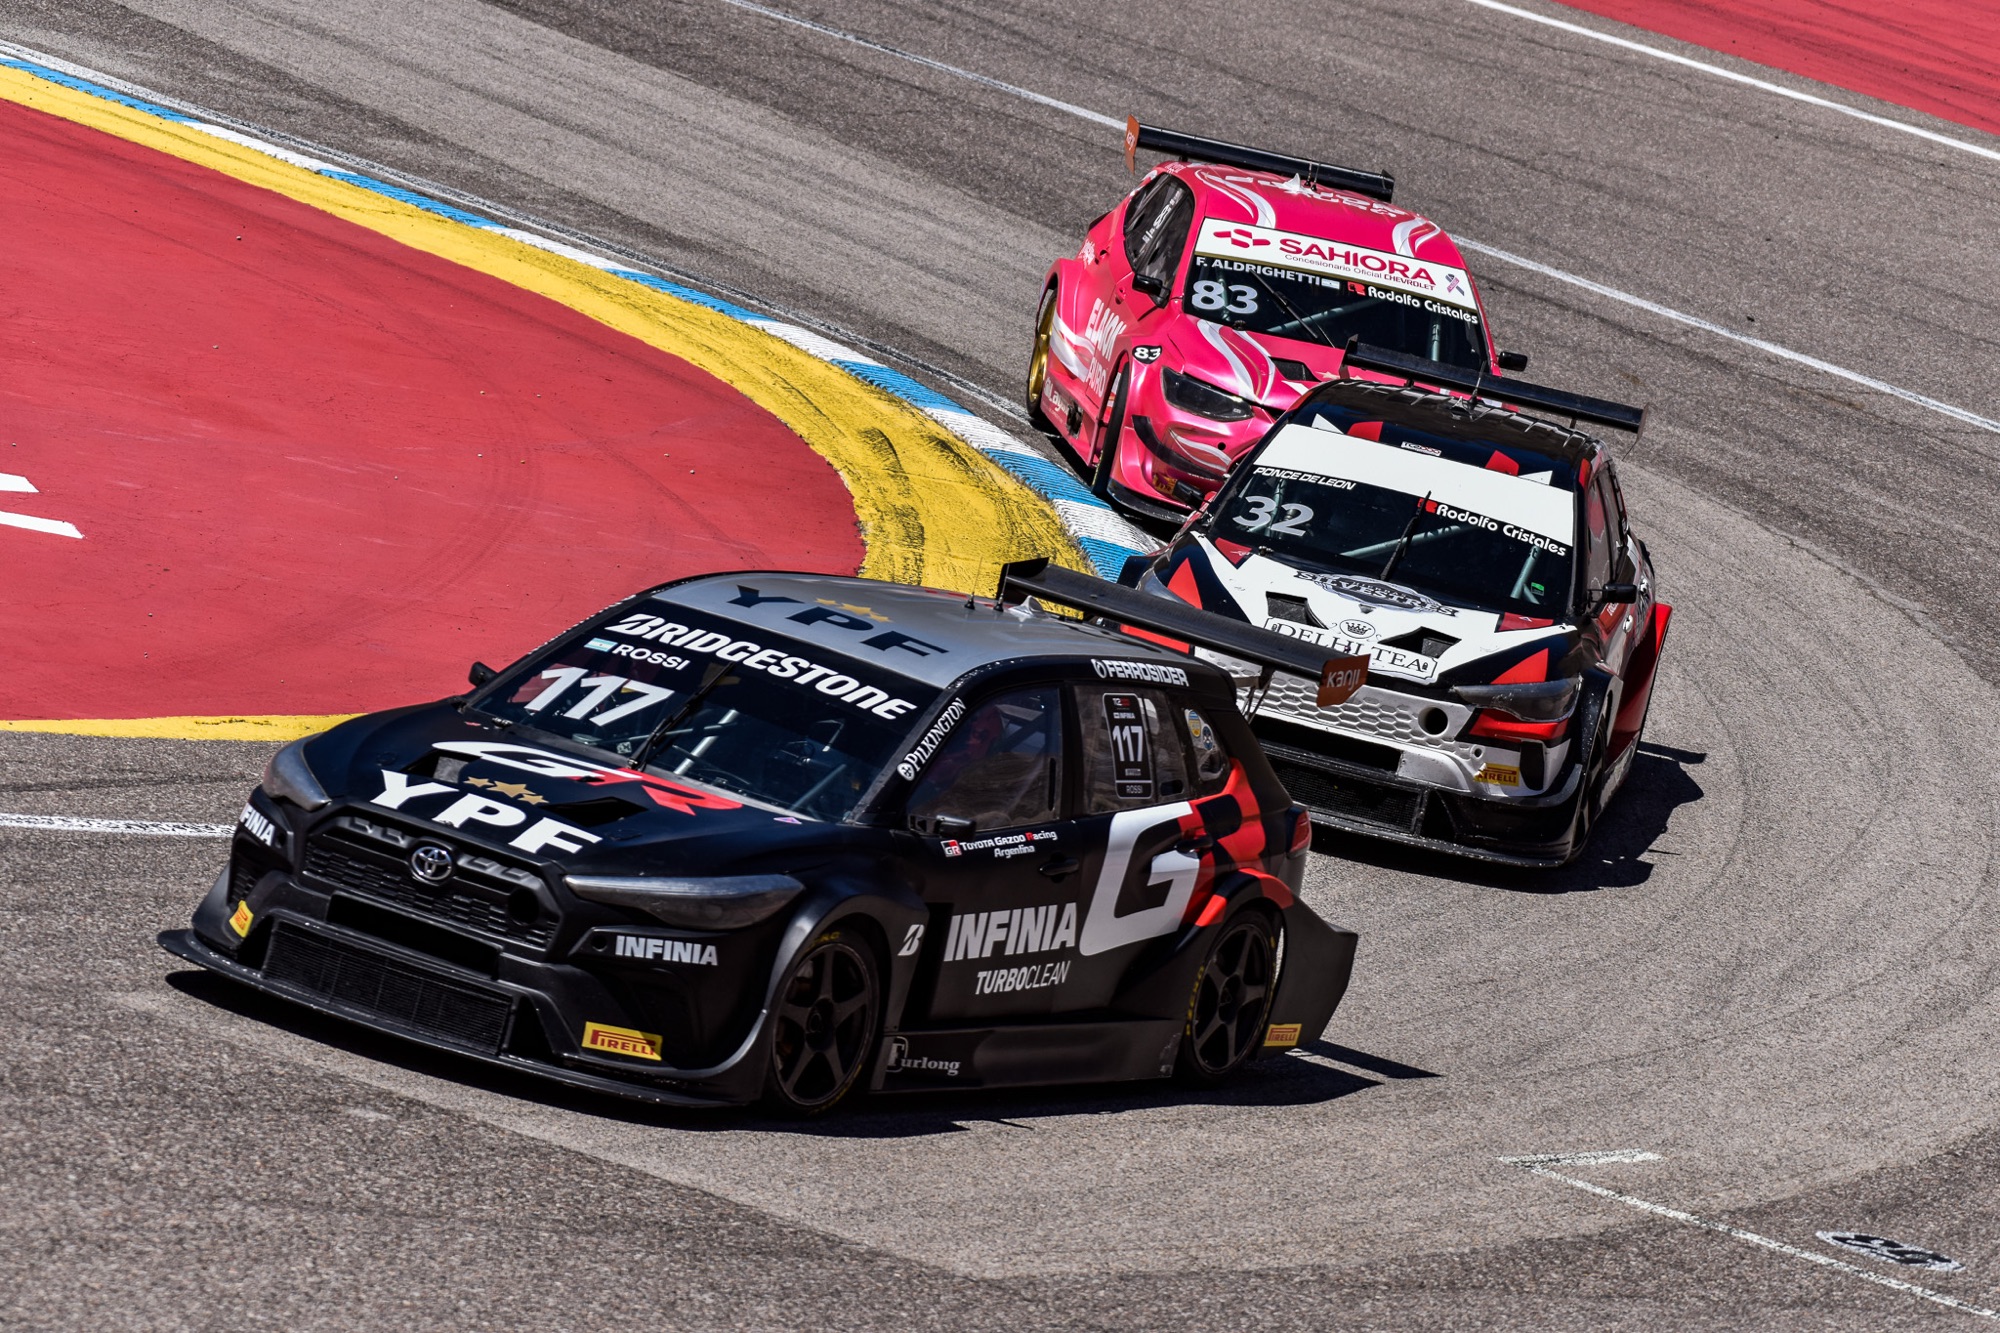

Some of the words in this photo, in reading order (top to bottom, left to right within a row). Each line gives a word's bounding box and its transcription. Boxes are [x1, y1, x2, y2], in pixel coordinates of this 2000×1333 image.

[1196, 256, 1207, 267] F.
[1212, 259, 1320, 286] ALDRIGHETTI
[1279, 239, 1436, 286] SAHIORA
[1285, 254, 1351, 272] Concesionario
[1353, 265, 1382, 279] Oficial
[1384, 271, 1435, 291] CHEVROLET
[1191, 280, 1258, 314] 83
[1367, 286, 1420, 308] Rodolfo
[1424, 300, 1478, 324] Cristales
[1134, 346, 1161, 360] 83
[1253, 466, 1302, 481] PONCE
[1299, 473, 1321, 484] DE
[1317, 476, 1356, 491] LEON
[1232, 495, 1314, 536] 32
[1436, 503, 1498, 531] Rodolfo
[1503, 524, 1567, 557] Cristales
[1293, 570, 1460, 617] SILVESTRES
[727, 584, 949, 657] YPF
[612, 643, 691, 671] ROSSI
[1276, 622, 1364, 656] DELHI
[1371, 646, 1423, 673] TEA
[604, 613, 918, 720] BRIDGESTONE
[1101, 659, 1189, 687] FERROSIDER
[1326, 669, 1361, 691] kanji
[524, 666, 675, 726] 117
[904, 697, 967, 771] PILKINGTON
[1112, 725, 1143, 761] 117
[371, 769, 603, 854] YPF
[960, 839, 995, 852] TOYOTA
[995, 834, 1026, 847] GAZOO
[1026, 830, 1058, 842] Racing
[994, 844, 1035, 859] Argentina
[944, 902, 1077, 962] INFINIA
[615, 935, 718, 966] INFINIA
[975, 960, 1071, 995] TURBOCLEAN
[590, 1029, 656, 1056] PIRELLI
[1267, 1027, 1298, 1042] PIRELLI
[887, 1042, 961, 1077] Furlong
